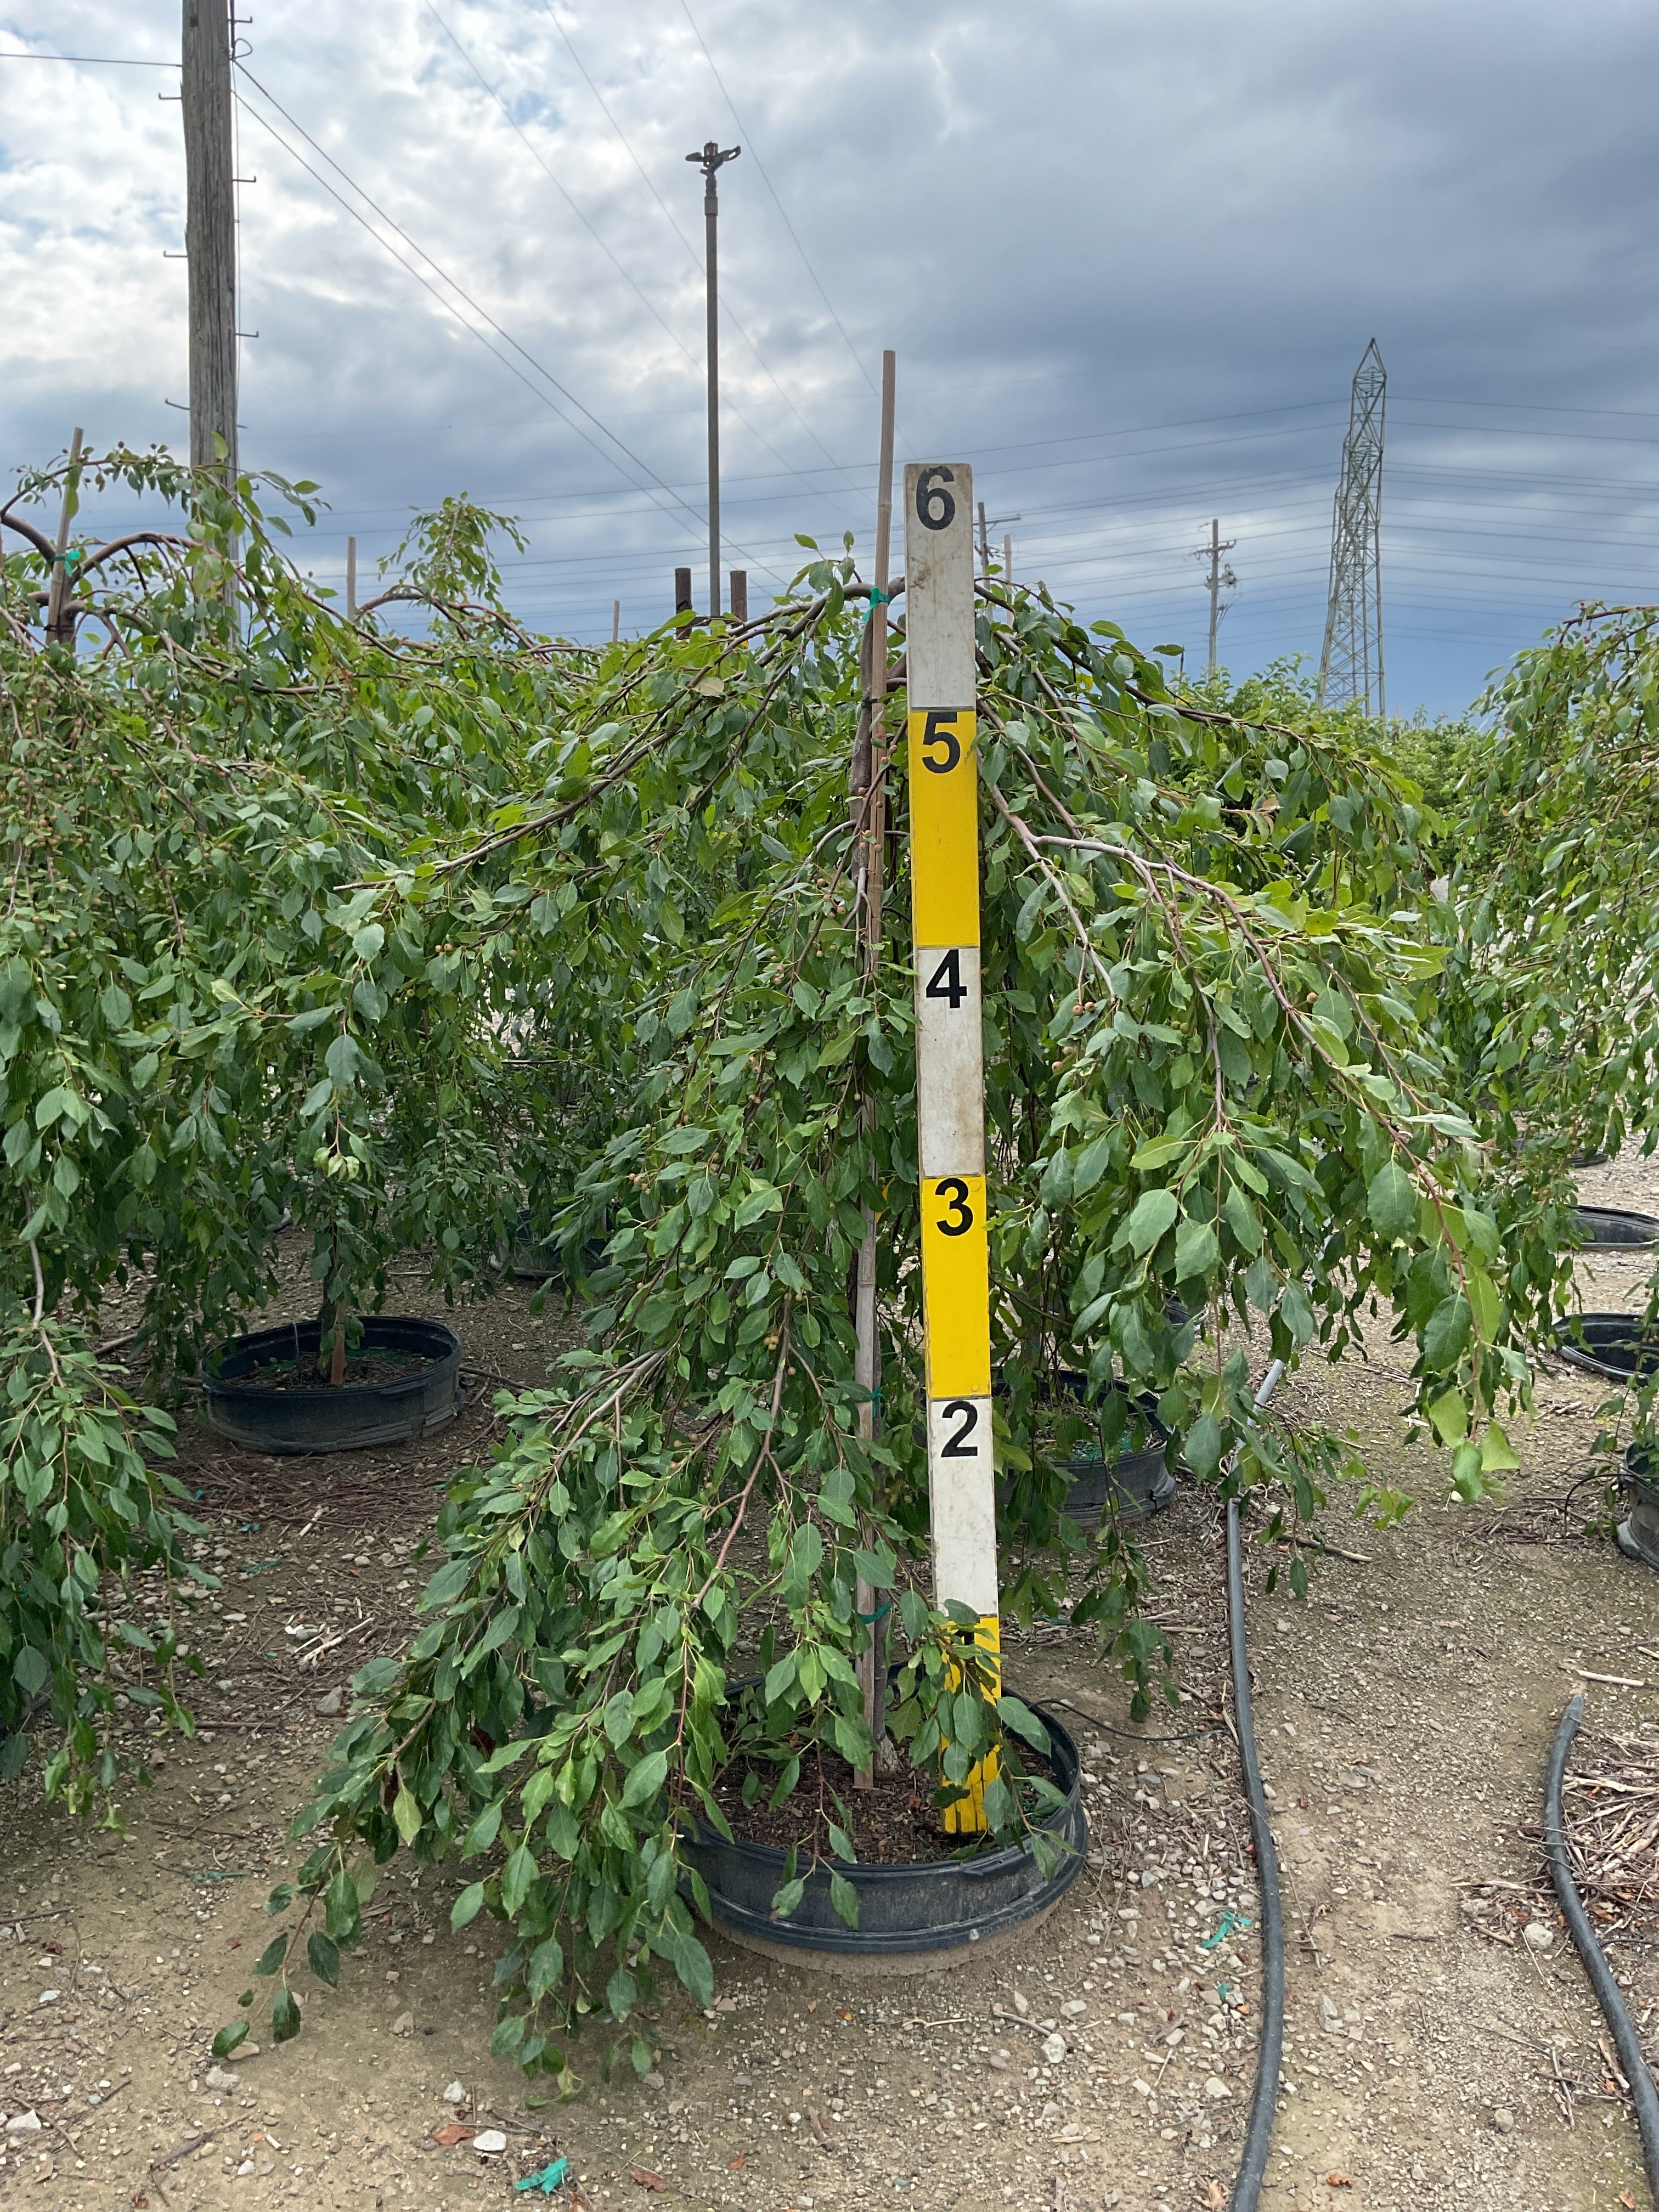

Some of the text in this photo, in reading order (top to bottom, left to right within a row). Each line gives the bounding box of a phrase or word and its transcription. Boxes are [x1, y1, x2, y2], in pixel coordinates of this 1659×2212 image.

[916, 465, 956, 531] 6
[922, 712, 961, 774] 5
[926, 949, 967, 1009] 4
[935, 1178, 973, 1236] 3
[941, 1400, 978, 1458] 2
